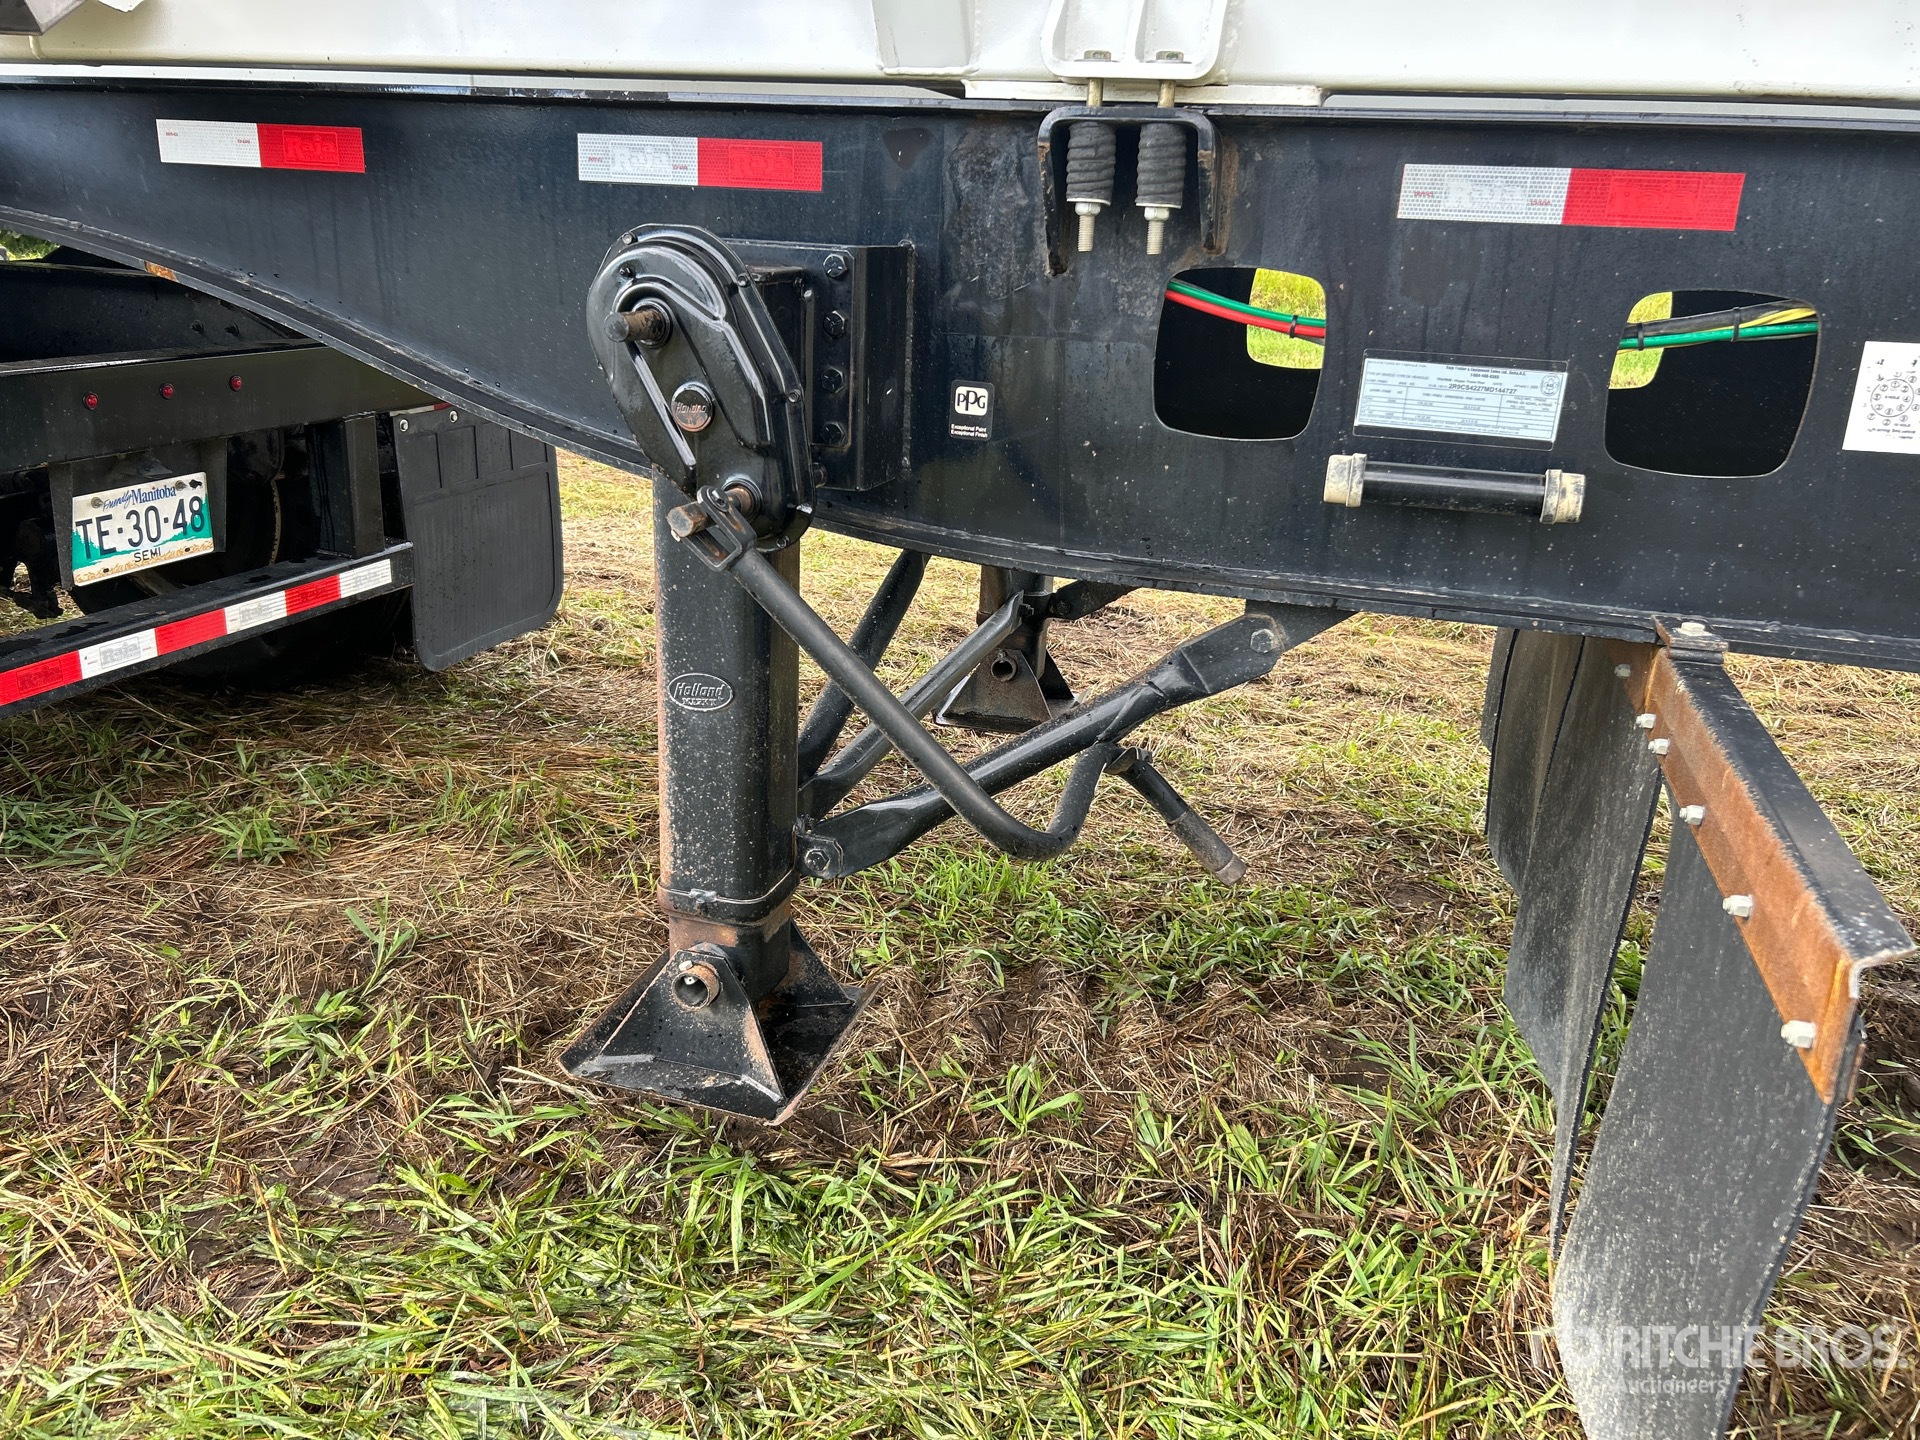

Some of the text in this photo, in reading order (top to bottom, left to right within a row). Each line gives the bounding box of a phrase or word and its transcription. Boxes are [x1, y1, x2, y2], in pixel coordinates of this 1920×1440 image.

[285, 134, 338, 160] Raja
[612, 146, 672, 173] Raja
[957, 390, 986, 411] PPG
[131, 485, 177, 504] Manitoba
[134, 547, 162, 563] SEMI
[674, 682, 726, 699] Holland
